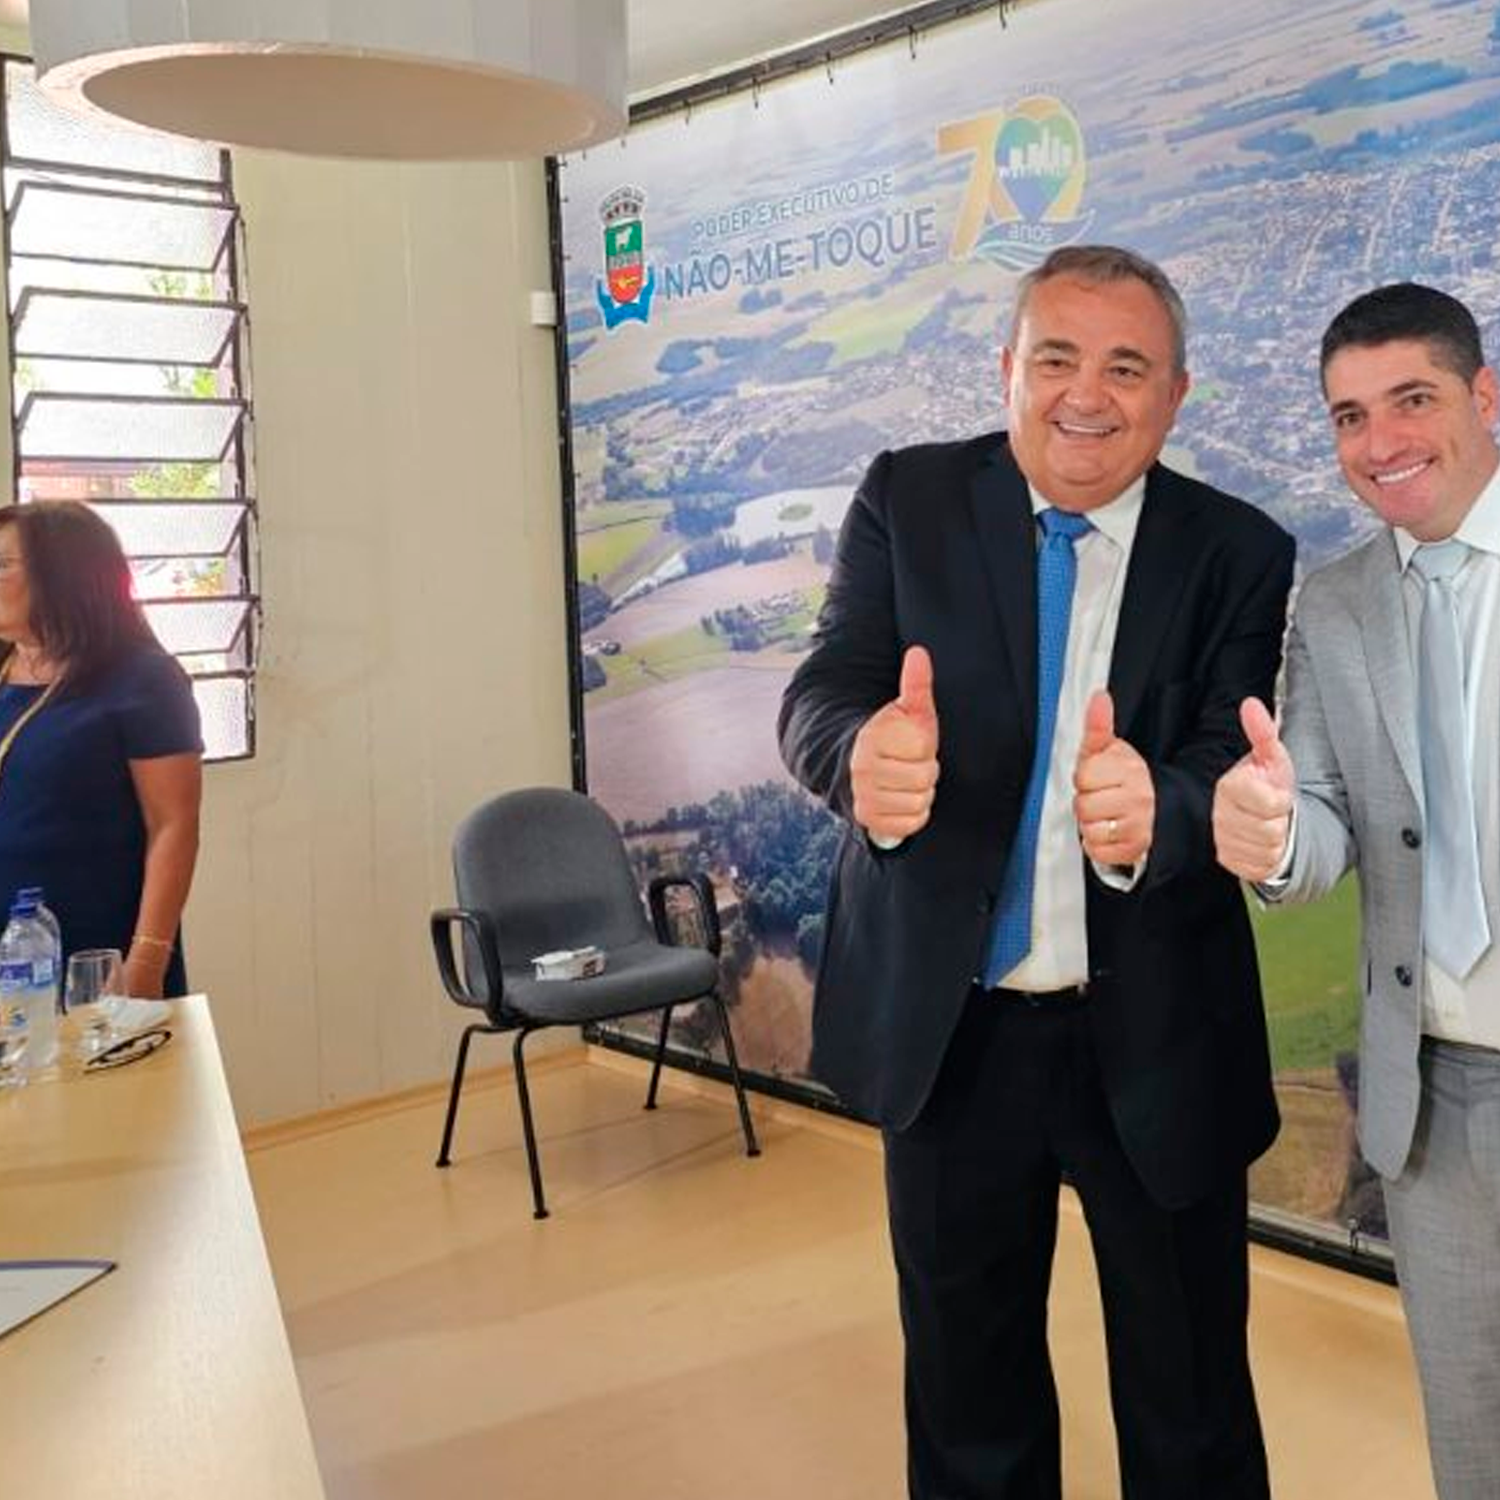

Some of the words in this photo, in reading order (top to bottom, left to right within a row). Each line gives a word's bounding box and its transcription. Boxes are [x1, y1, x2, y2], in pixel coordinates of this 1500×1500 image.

[692, 209, 750, 238] PODER
[757, 183, 860, 226] EXECUTIVO
[865, 173, 893, 198] DE
[664, 207, 936, 299] NÃO-ME-TOQUE
